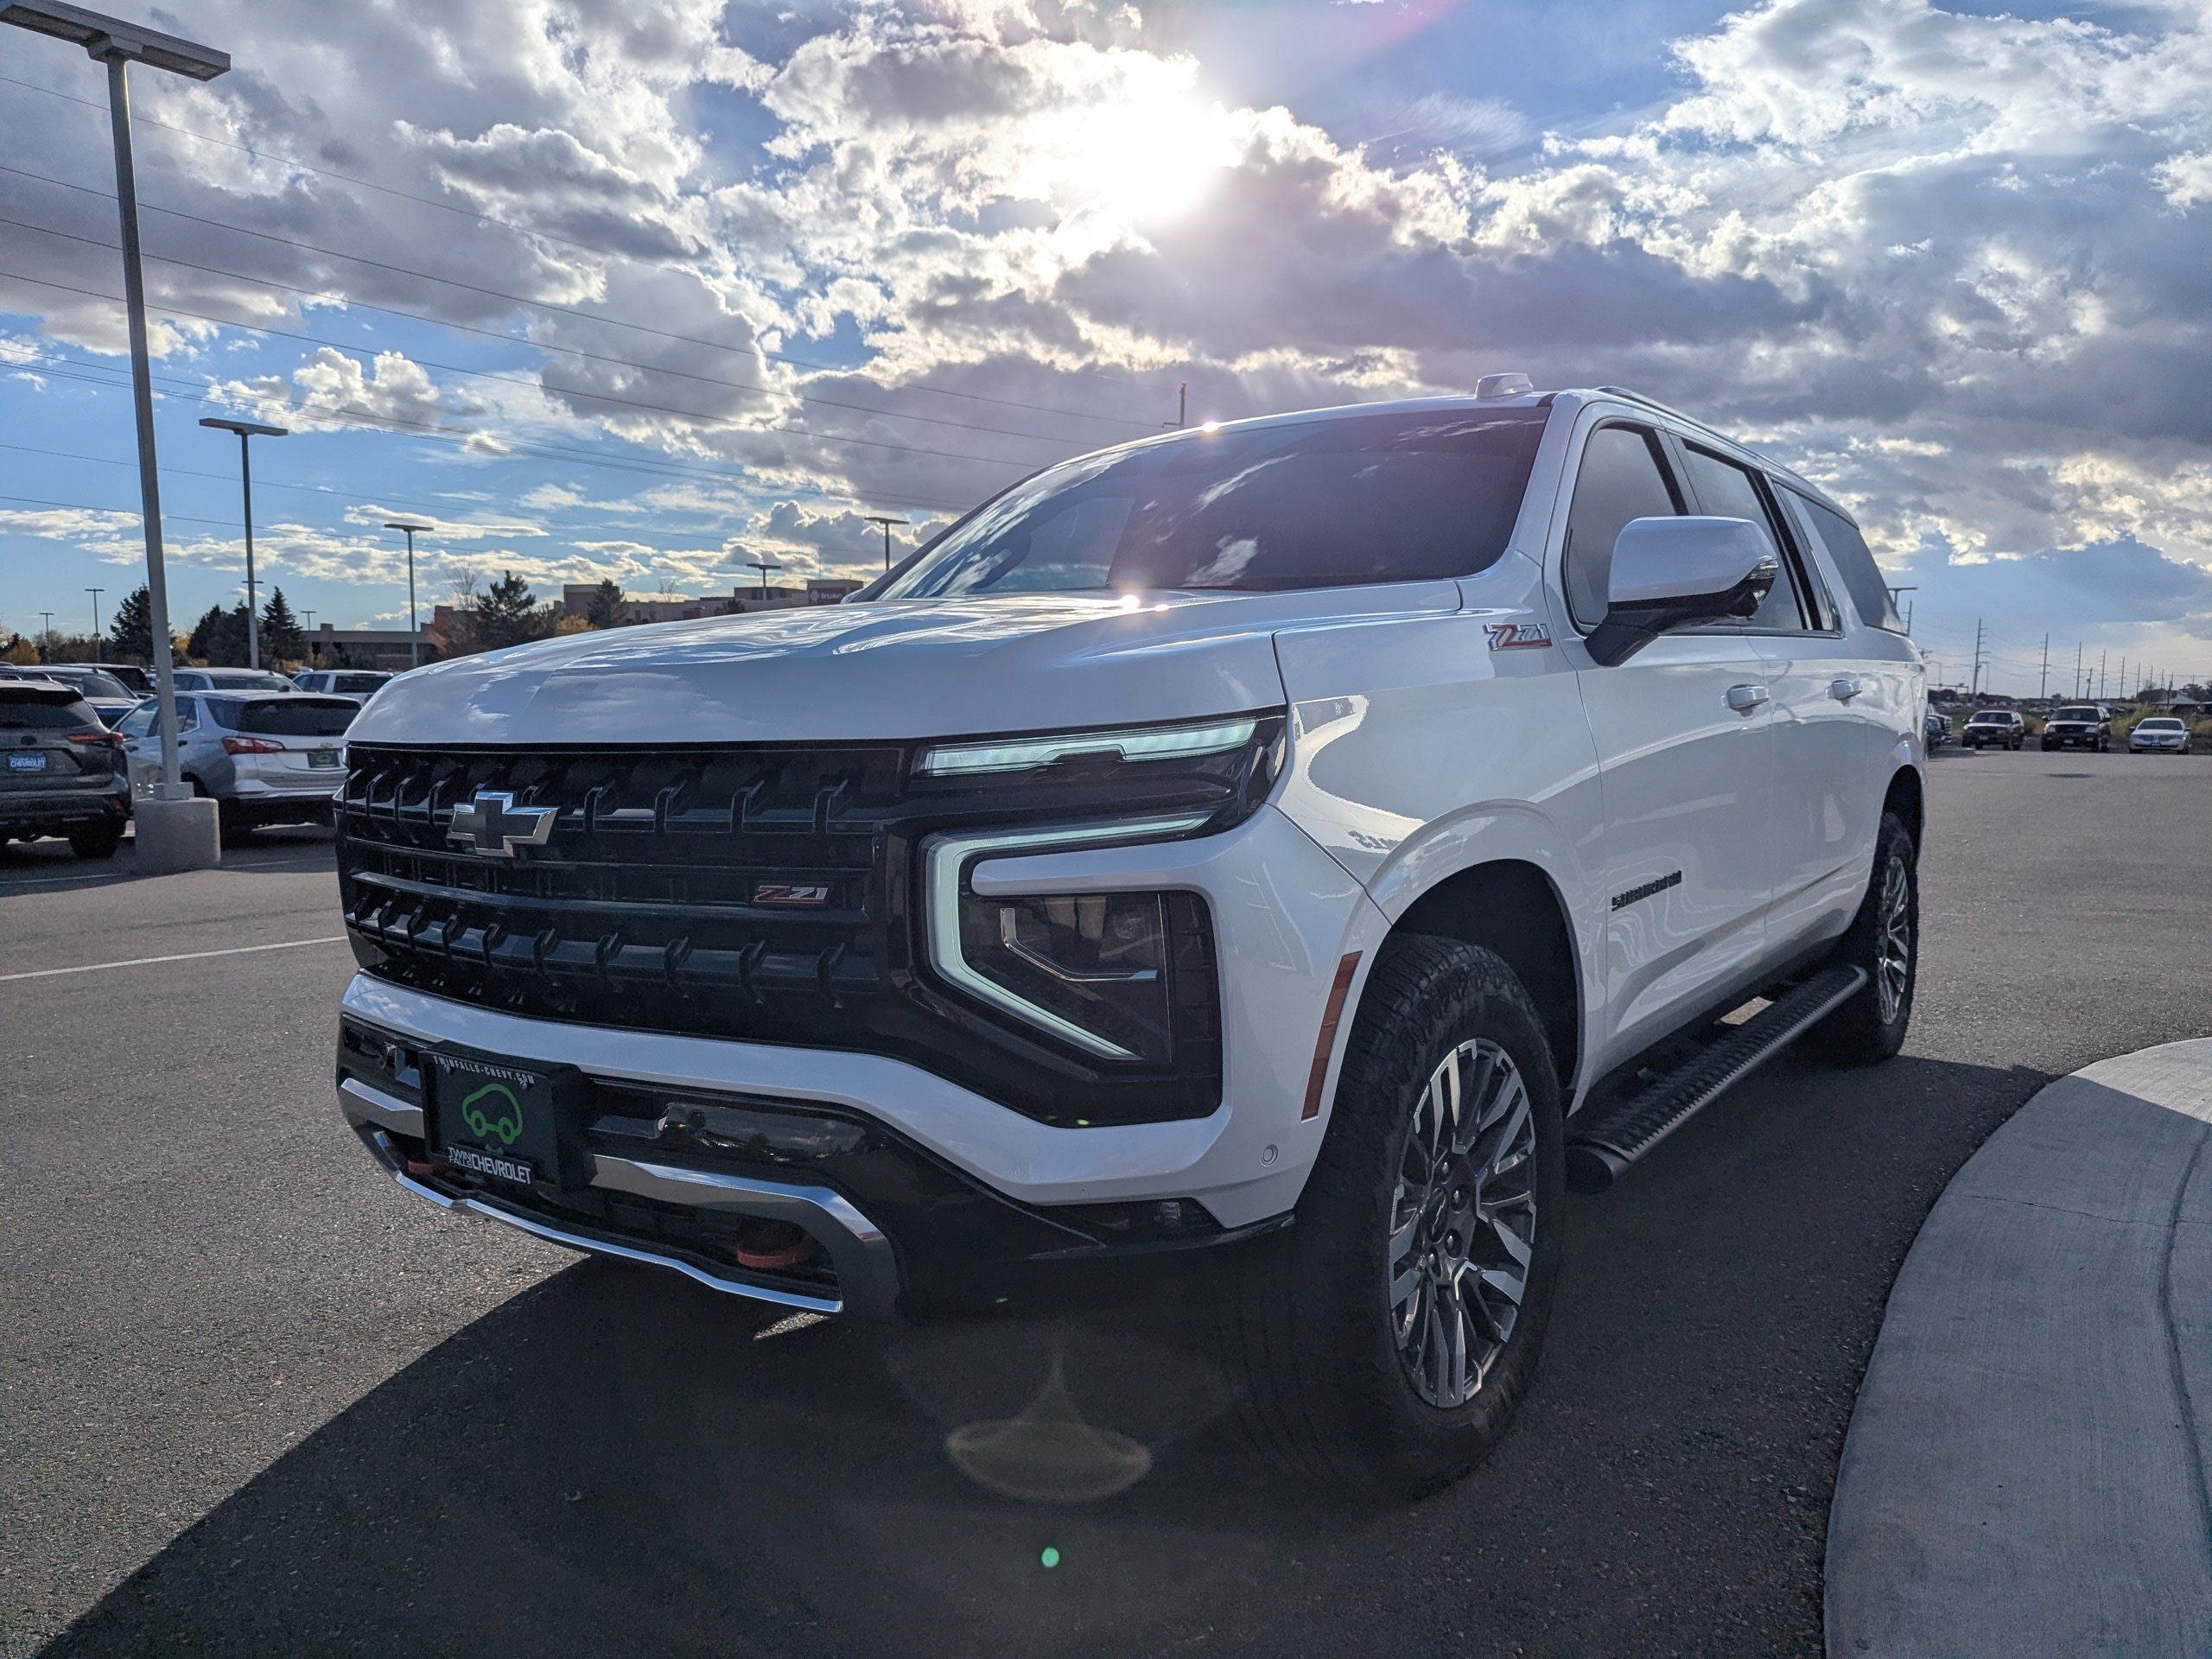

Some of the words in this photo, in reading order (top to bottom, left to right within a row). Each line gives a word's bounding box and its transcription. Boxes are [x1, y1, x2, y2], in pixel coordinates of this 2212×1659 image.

[1483, 622, 1553, 651] Z71
[753, 885, 829, 904] Z71
[1611, 870, 1681, 912] SUBURBAN
[433, 1055, 535, 1084] TWINFALLS-CHEVY.COM
[448, 1147, 472, 1161] TWIN
[449, 1158, 473, 1169] FALLS
[471, 1153, 531, 1185] CHEVROLET
